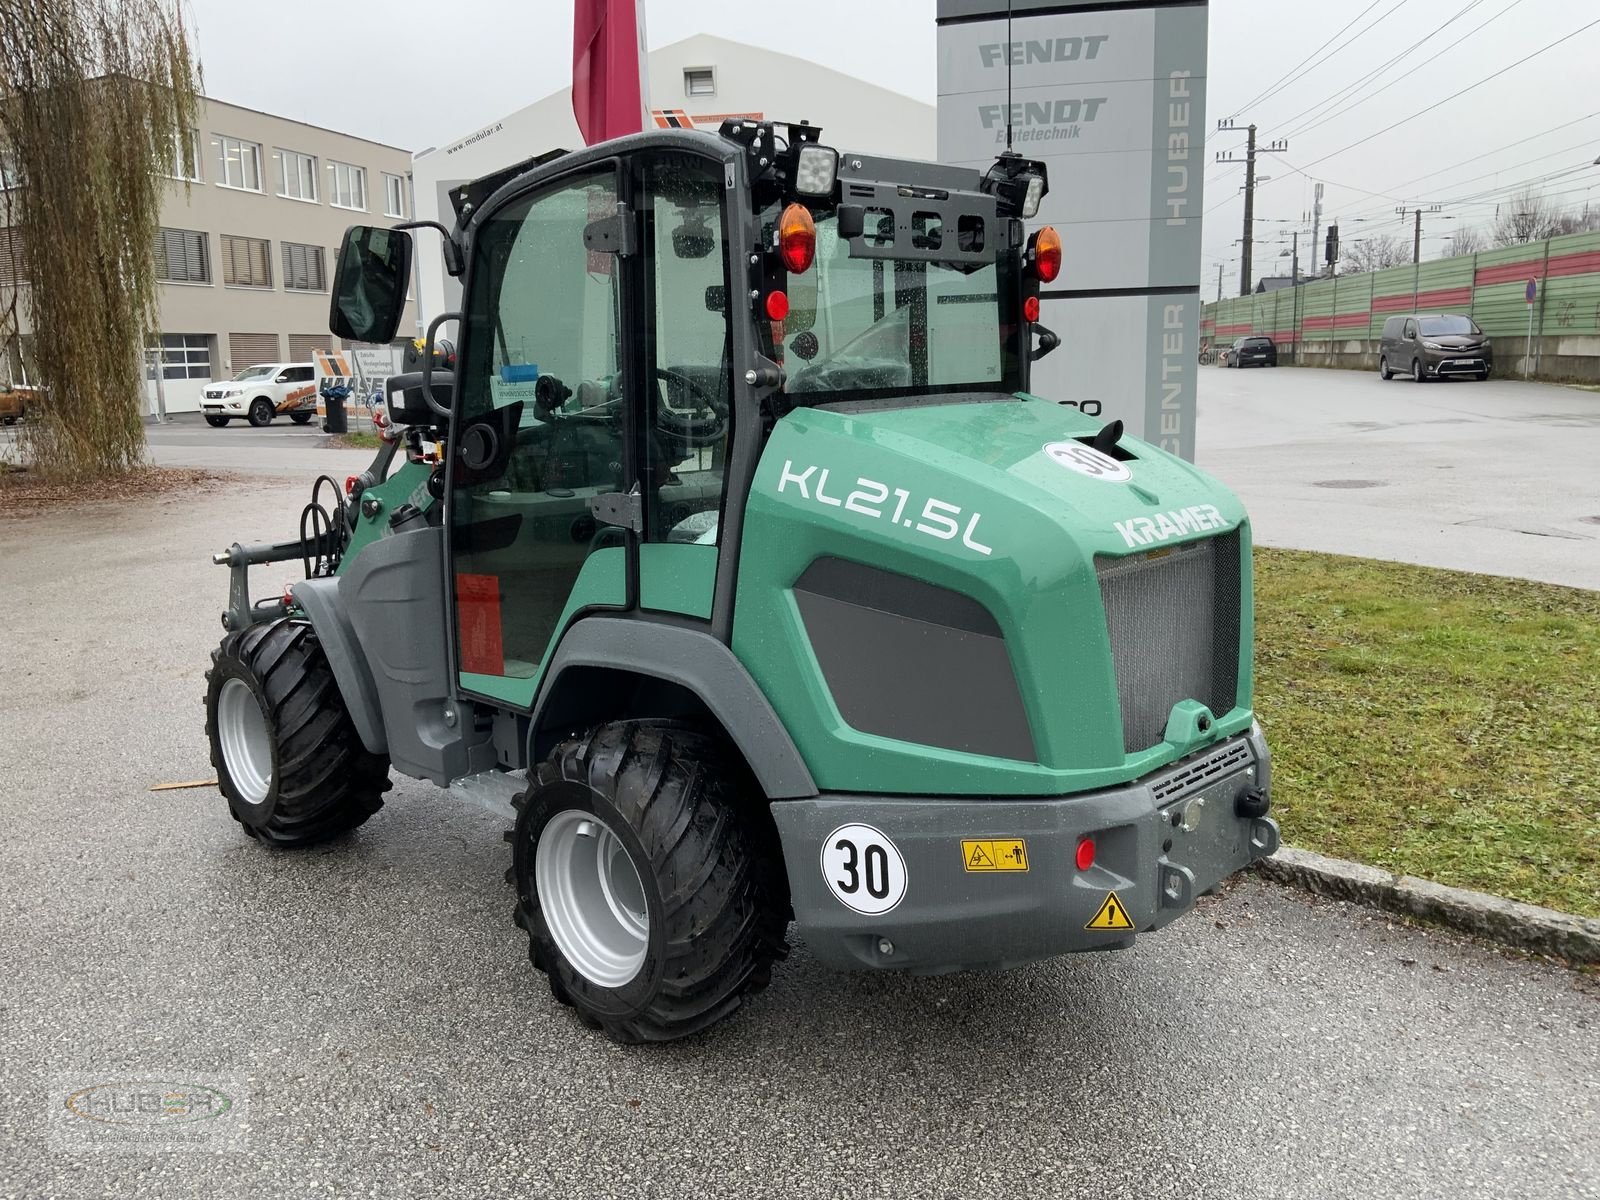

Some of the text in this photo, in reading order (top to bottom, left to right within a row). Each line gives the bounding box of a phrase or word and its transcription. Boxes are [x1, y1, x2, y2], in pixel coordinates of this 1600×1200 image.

[978, 35, 1109, 68] FENDT
[978, 97, 1108, 129] FENDT
[446, 123, 504, 155] www.modular.at
[1165, 69, 1191, 226] HUBER
[1160, 303, 1185, 457] CENTER
[1057, 399, 1102, 417] O
[1053, 447, 1121, 476] 30
[778, 460, 993, 556] KL21.5L
[1113, 503, 1230, 548] KRAMER
[836, 838, 891, 900] 30
